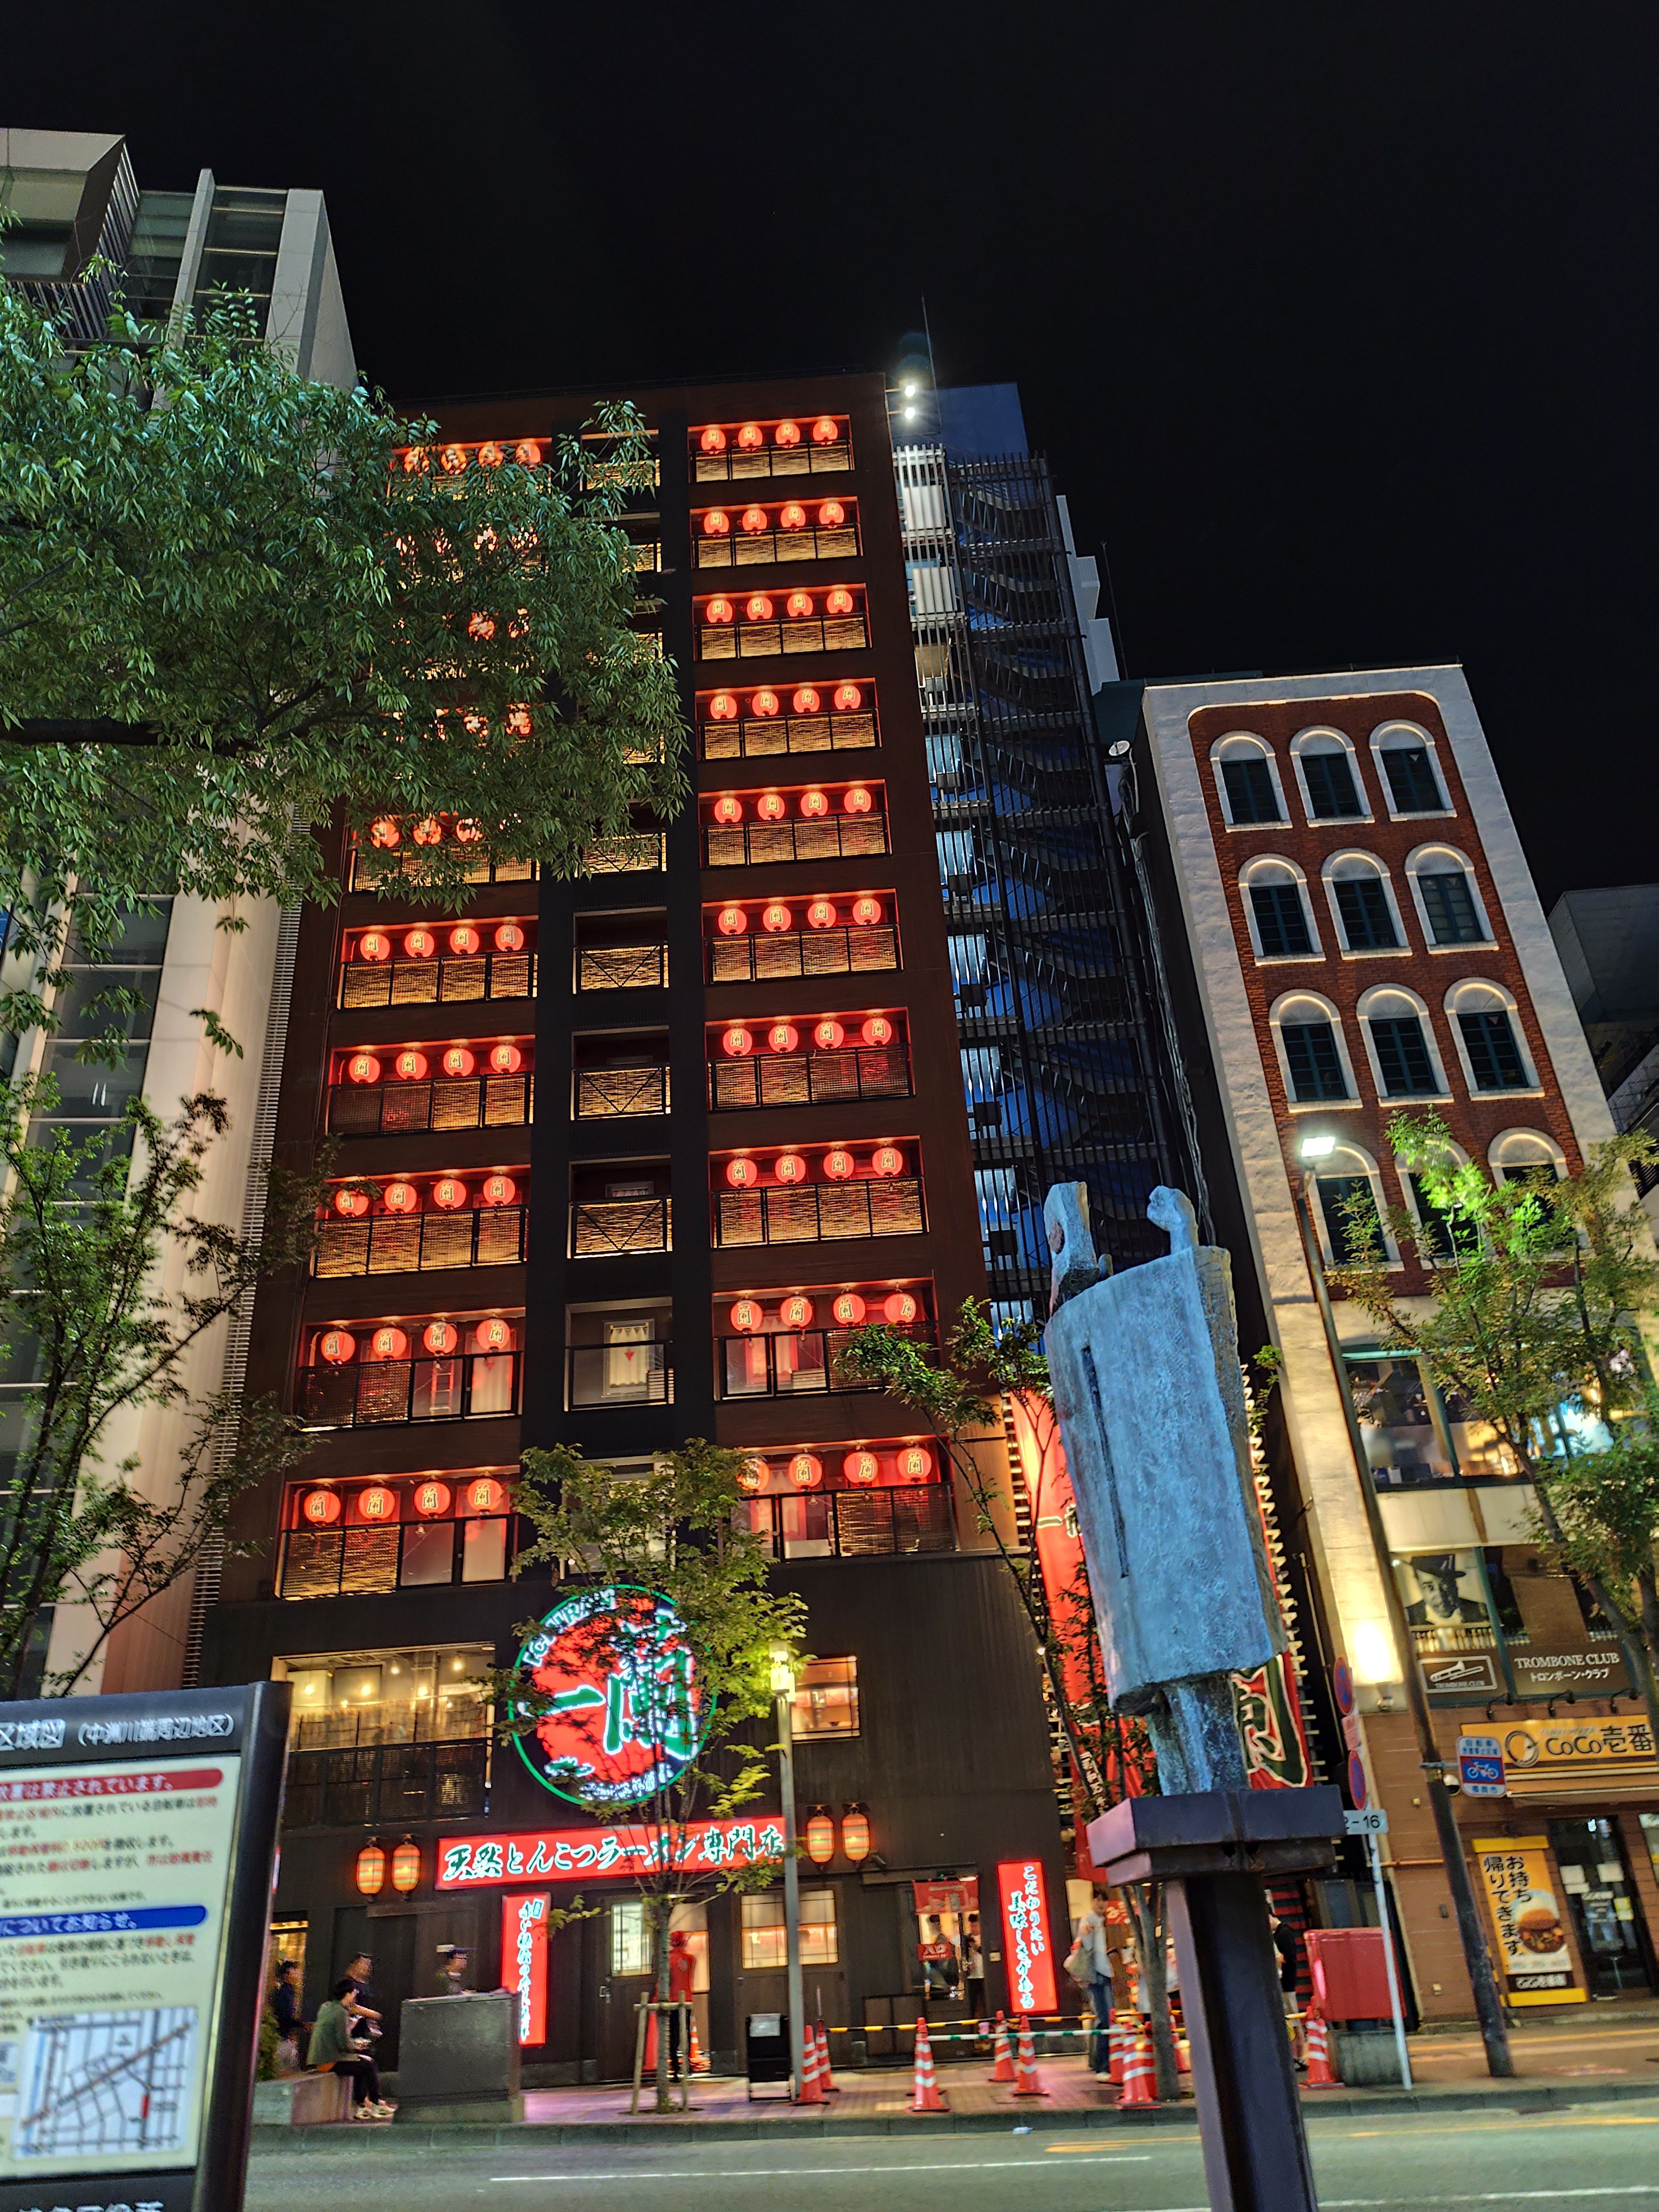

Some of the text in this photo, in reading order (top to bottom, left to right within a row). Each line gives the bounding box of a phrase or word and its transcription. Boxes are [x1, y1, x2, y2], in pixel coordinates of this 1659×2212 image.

[1514, 1652, 1620, 1669] TROMBONE CLUB
[1530, 1668, 1610, 1683] トロンボーン・クラブ
[1023, 1866, 1045, 1956] こだわりたい
